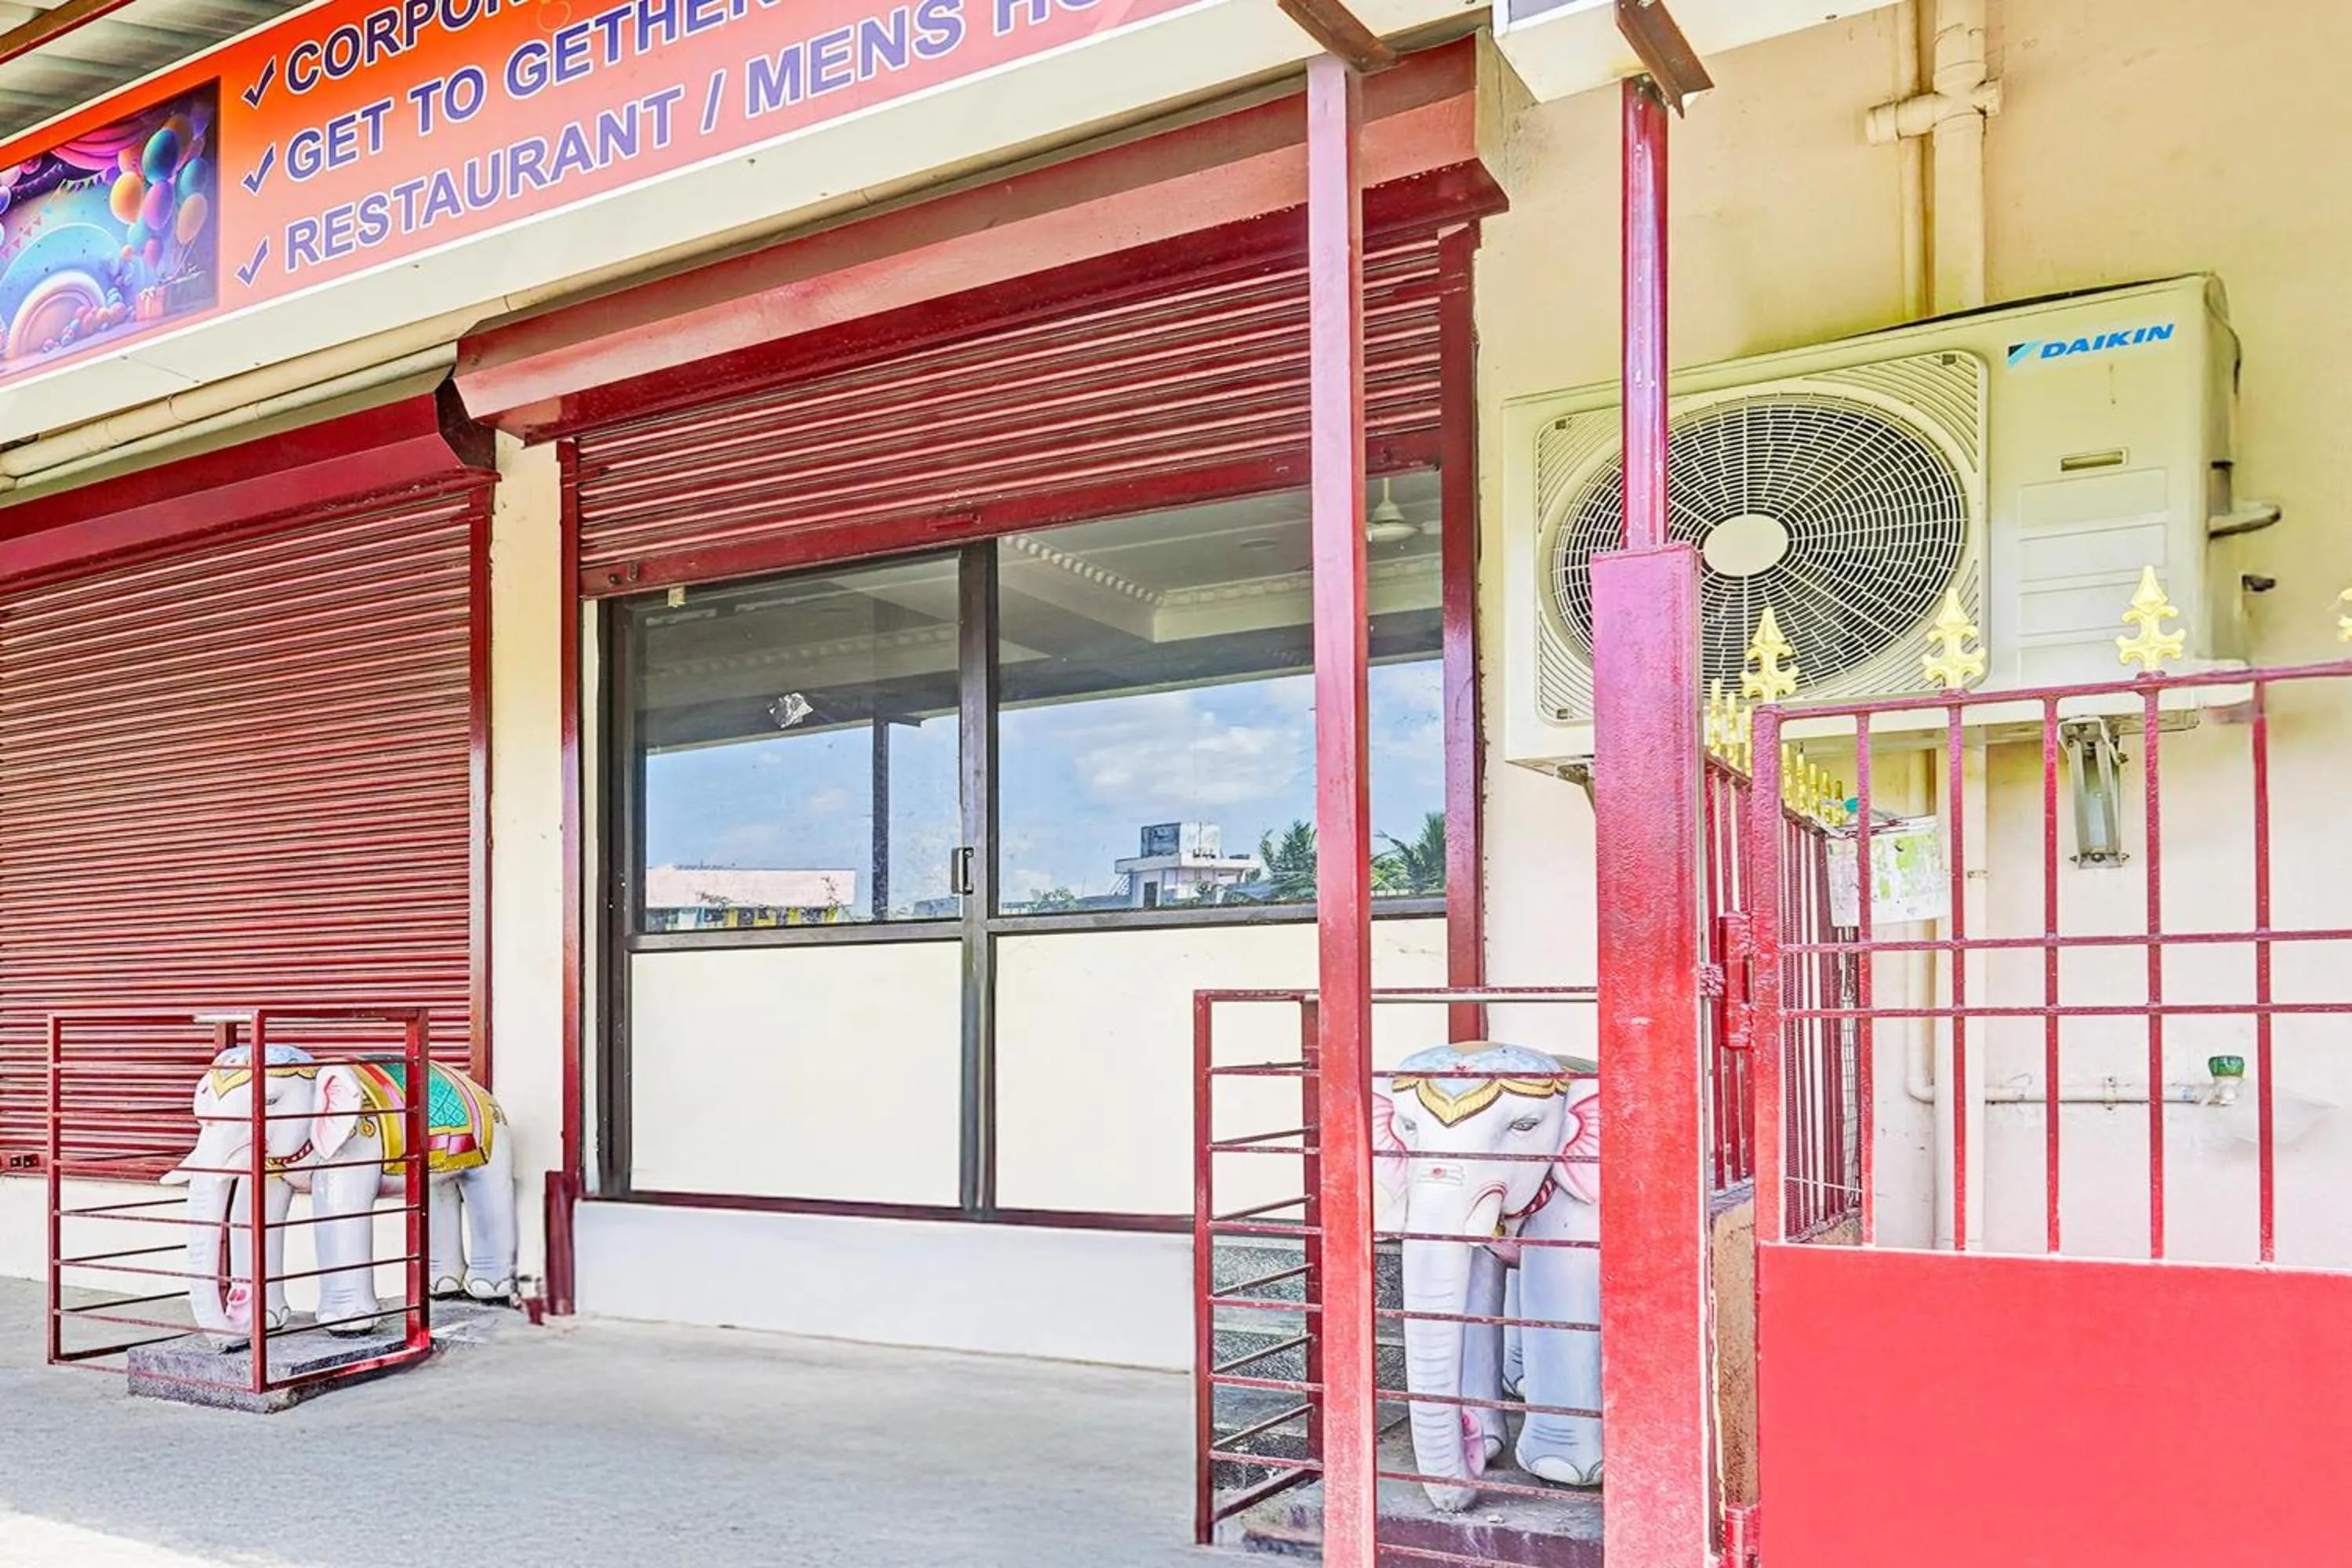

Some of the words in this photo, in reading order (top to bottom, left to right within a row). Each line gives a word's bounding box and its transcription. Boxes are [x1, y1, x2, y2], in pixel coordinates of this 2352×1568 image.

[287, 0, 528, 92] CORPO
[287, 100, 391, 180] GET
[409, 67, 485, 133] TO
[507, 0, 782, 96] GETHE
[288, 87, 682, 270] RESTAURANT
[703, 71, 724, 132] /
[748, 0, 963, 115] MENS
[2040, 324, 2175, 359] DAIKIN
